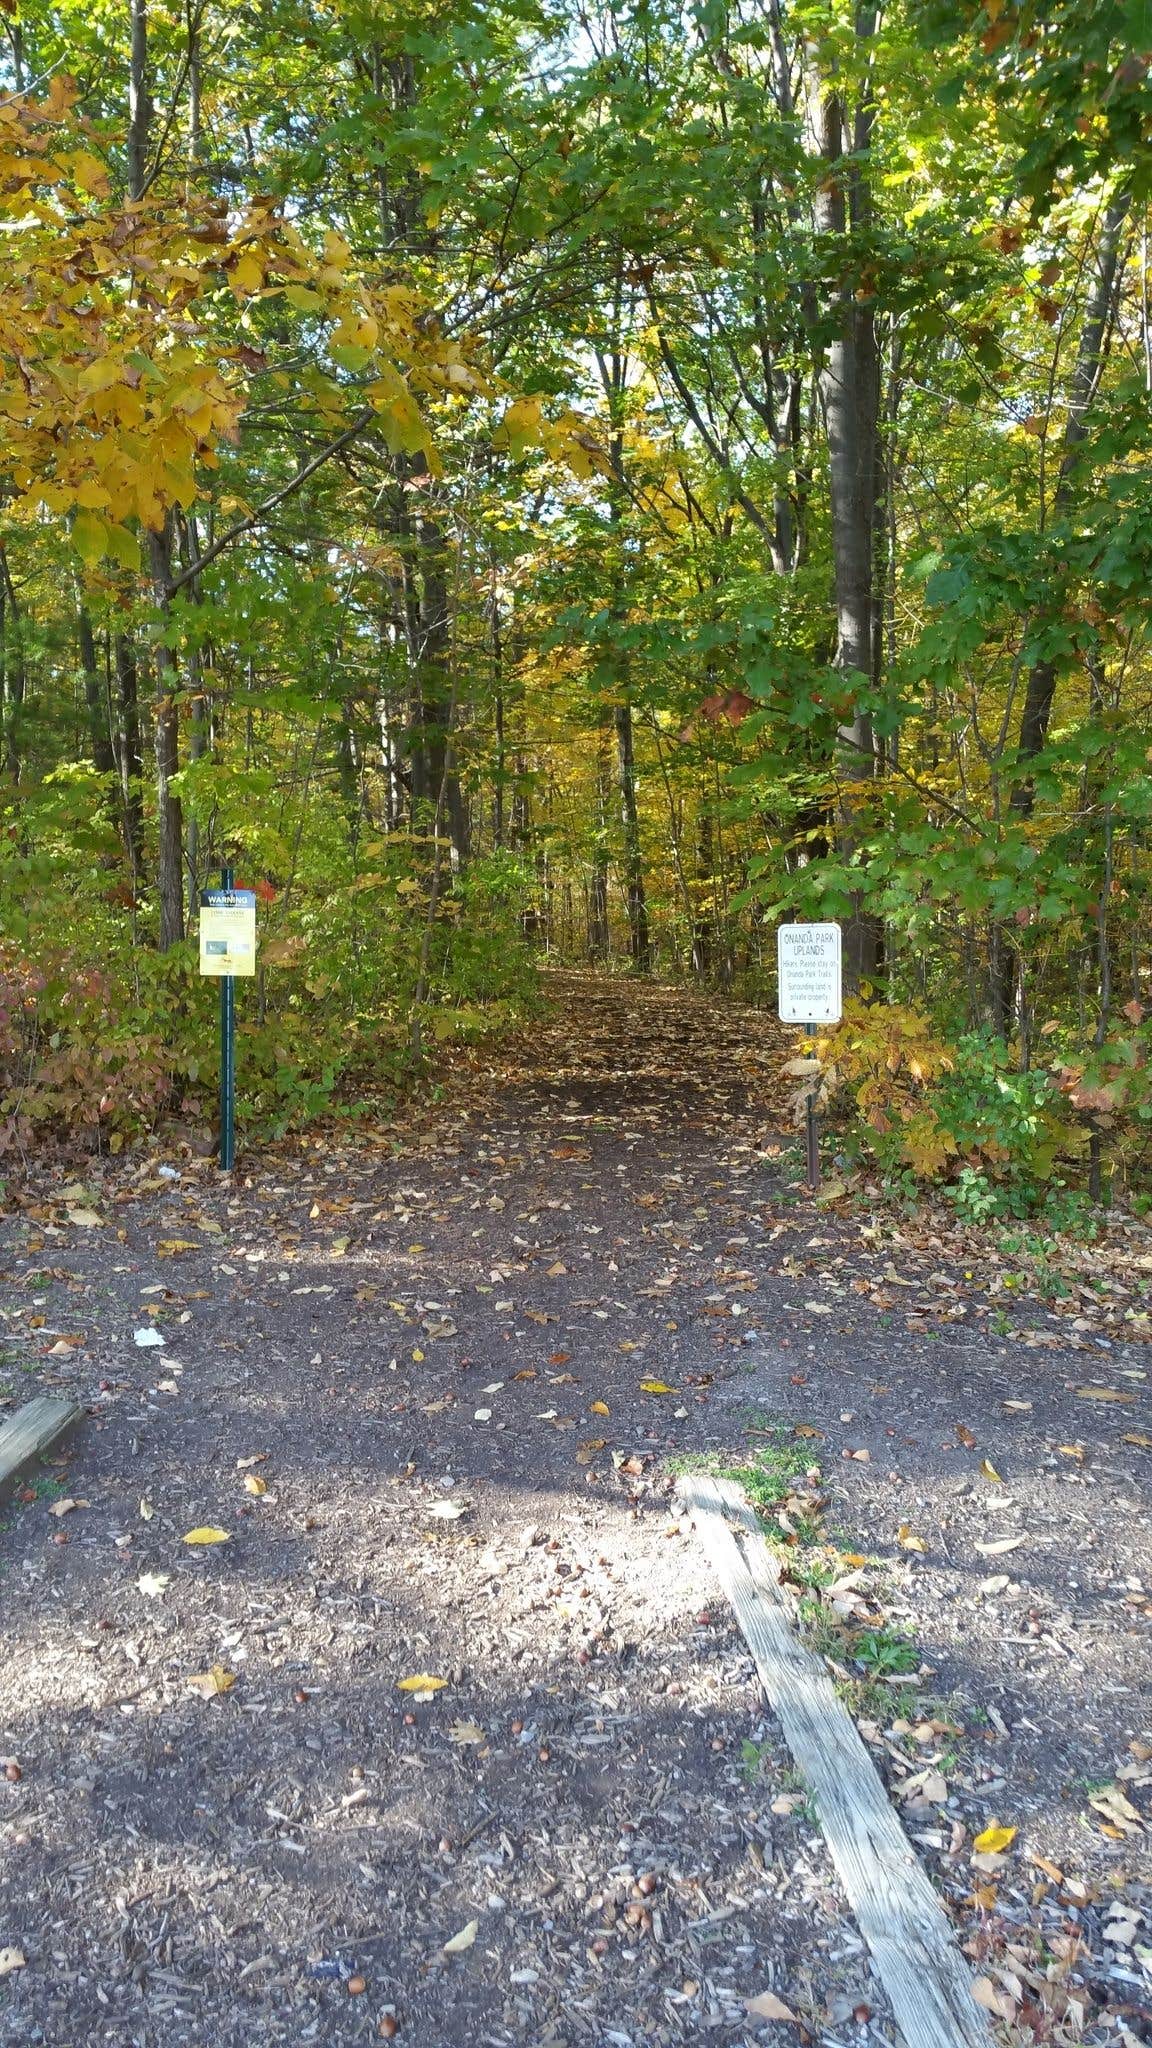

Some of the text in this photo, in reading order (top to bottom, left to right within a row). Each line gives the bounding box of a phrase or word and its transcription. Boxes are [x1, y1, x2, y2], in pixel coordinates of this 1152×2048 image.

[208, 895, 248, 904] WARNING
[784, 933, 834, 944] ONANDA PARK
[793, 945, 825, 956] UPLANDS
[805, 970, 816, 978] Park
[788, 983, 814, 992] Surrounding
[790, 992, 807, 1001] private
